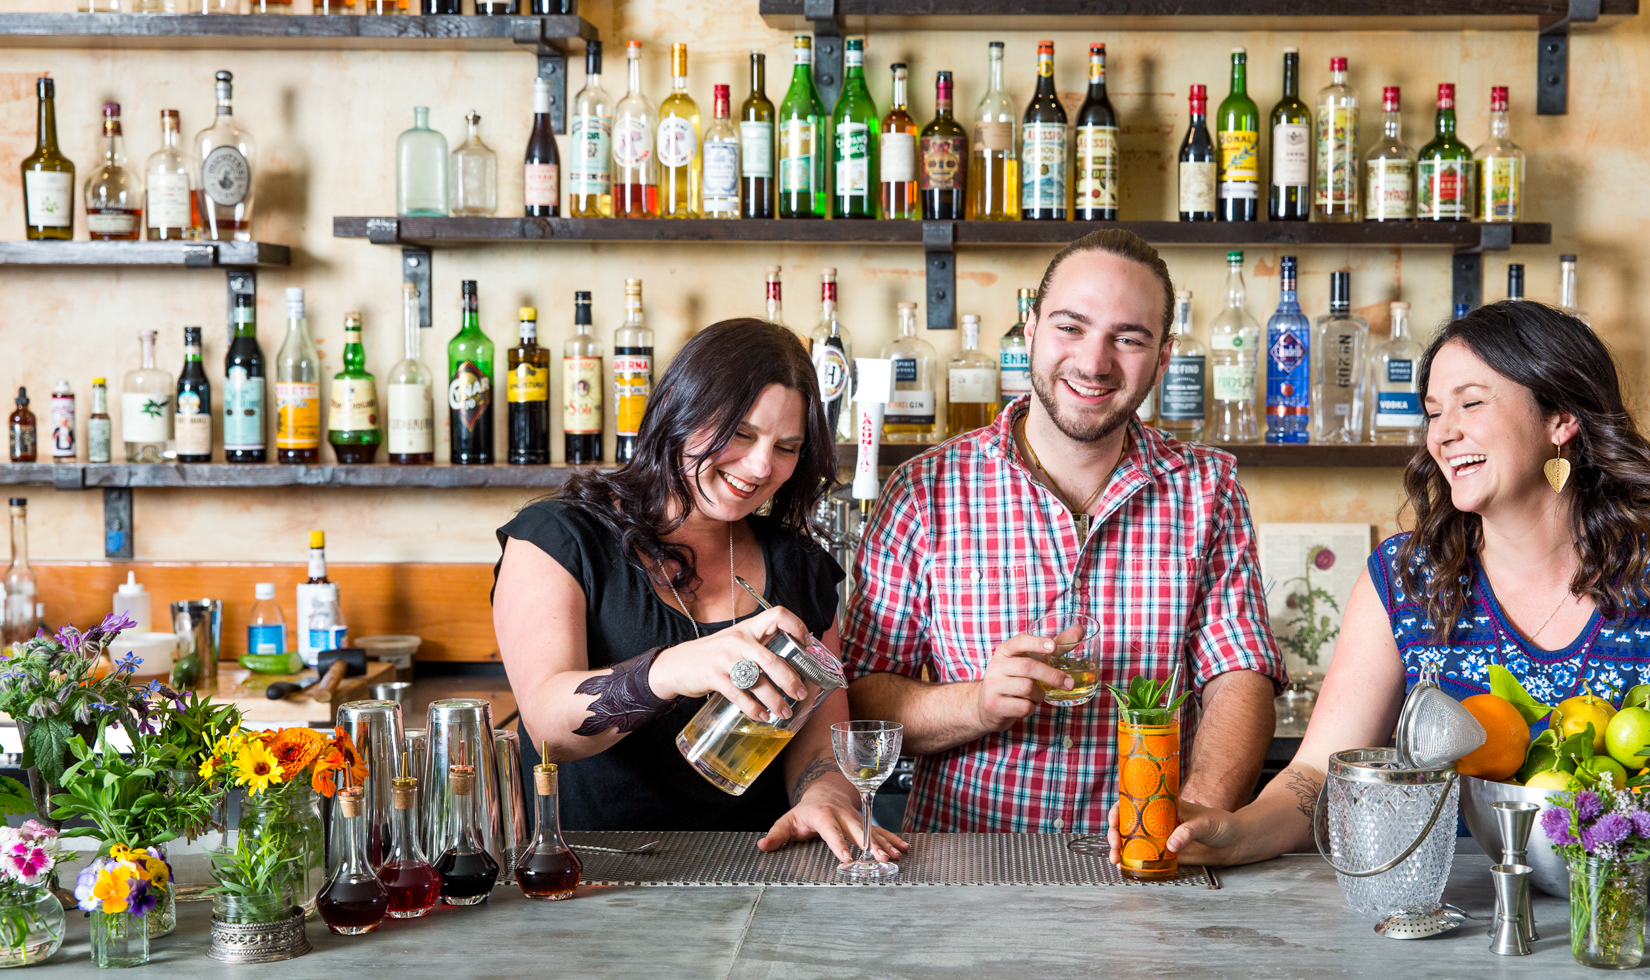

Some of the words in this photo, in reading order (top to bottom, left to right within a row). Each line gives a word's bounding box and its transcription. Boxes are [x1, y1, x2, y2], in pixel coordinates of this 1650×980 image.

[1027, 129, 1063, 140] ALSSIO
[1219, 131, 1253, 147] BONAL
[1078, 137, 1114, 149] ALSSIO
[1001, 354, 1030, 364] ENH
[1337, 357, 1353, 389] 209
[909, 401, 924, 409] GIN
[1379, 400, 1409, 410] VODKA
